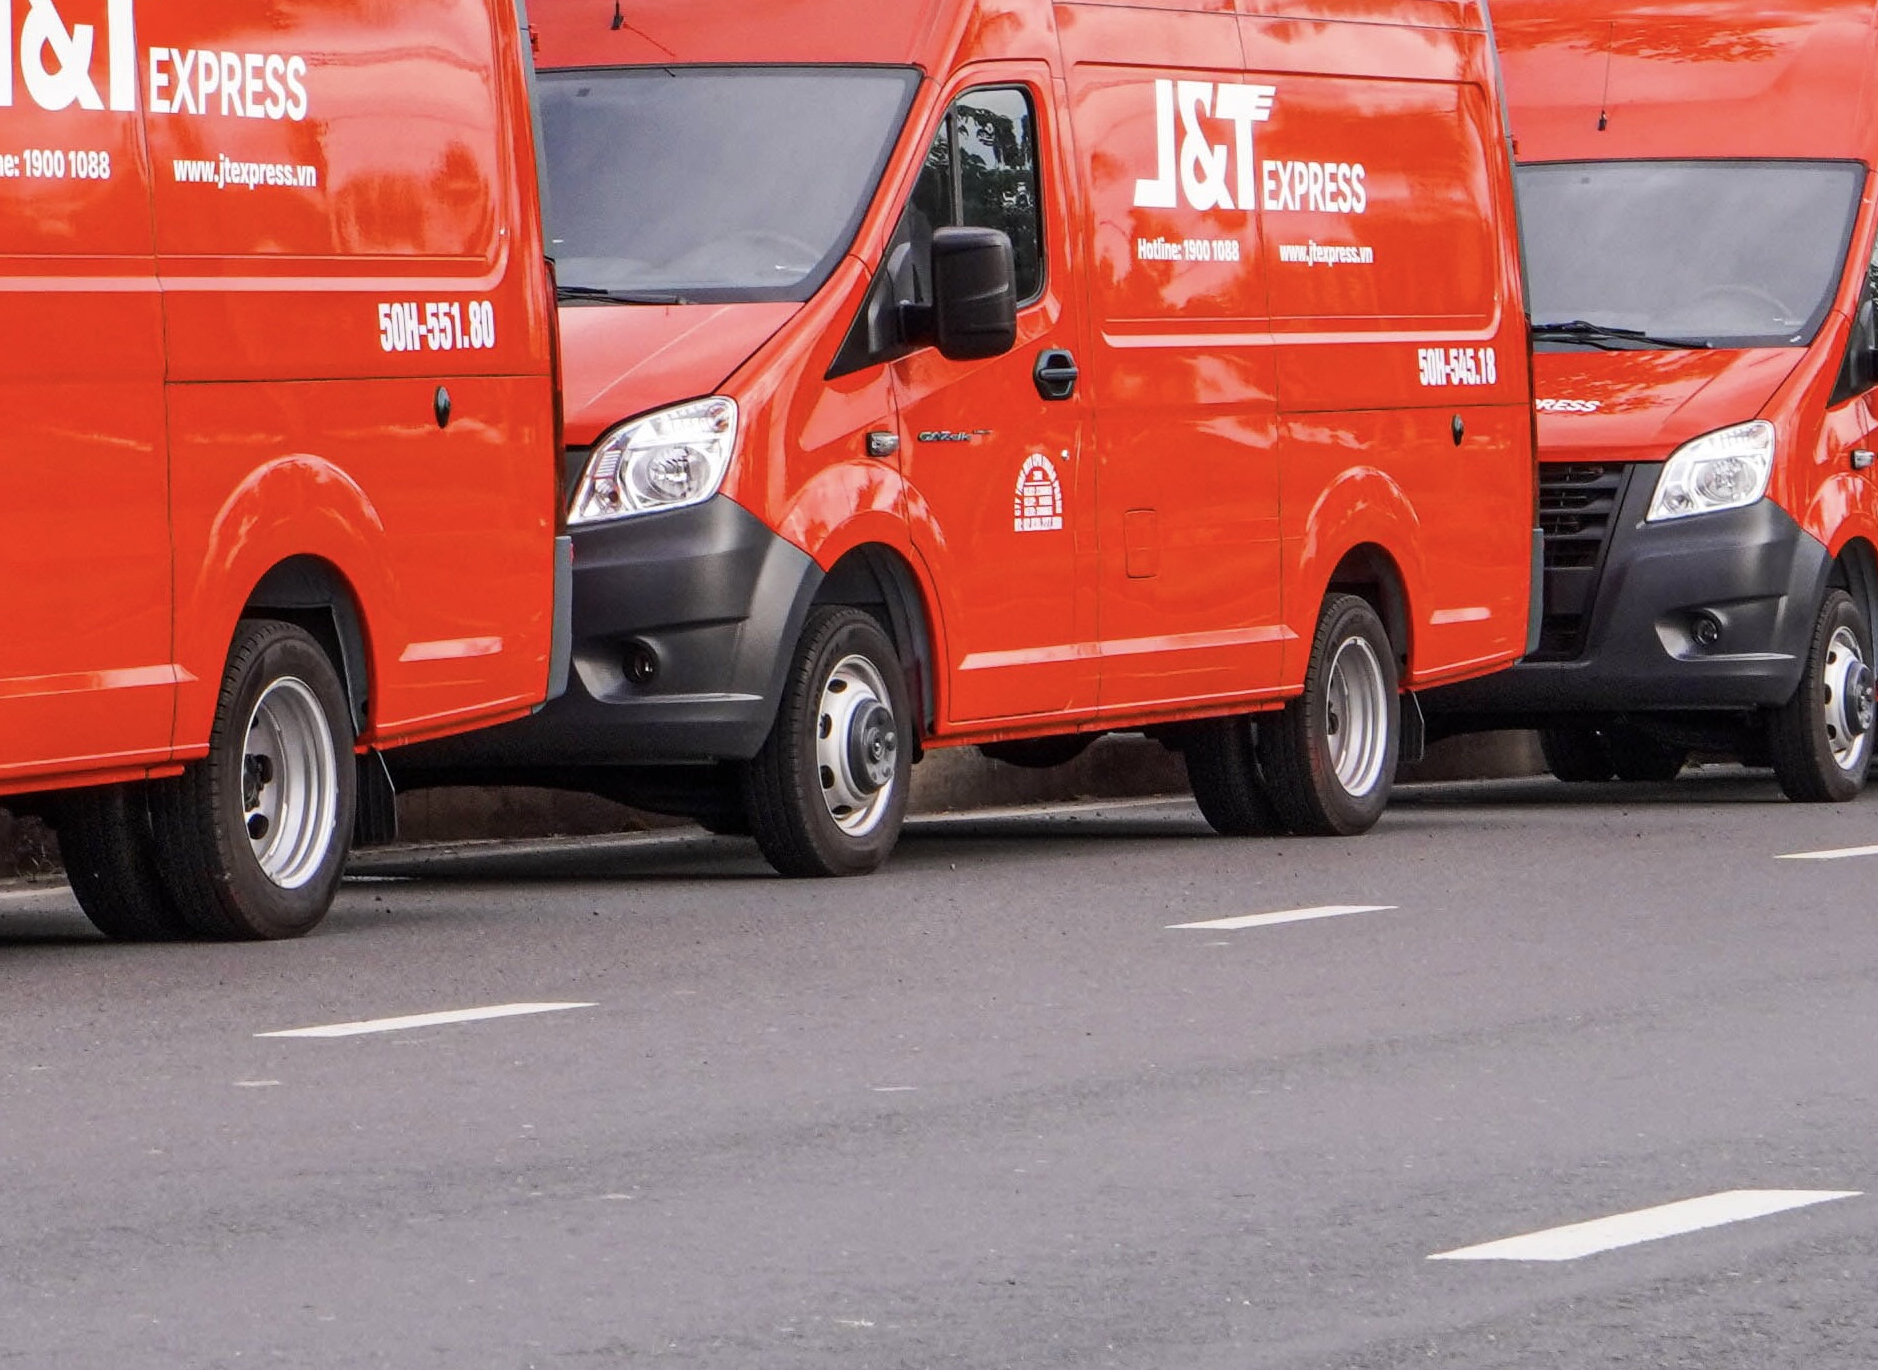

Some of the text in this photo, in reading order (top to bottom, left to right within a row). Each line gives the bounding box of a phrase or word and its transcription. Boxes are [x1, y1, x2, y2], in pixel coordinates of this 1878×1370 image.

[149, 46, 308, 121] EXPRESS
[23, 149, 65, 179] 1900
[68, 150, 110, 180] 1088
[1133, 79, 1367, 214] J&T EXPRESS
[173, 153, 317, 190] www.jtexpress.vn
[1137, 237, 1240, 261] Hotline: 1900 1088
[1279, 240, 1373, 267] www.jtexpress.vn
[378, 299, 495, 352] 50H-551.80
[1418, 347, 1496, 386] 50H-545.18
[1535, 398, 1601, 412] RESS
